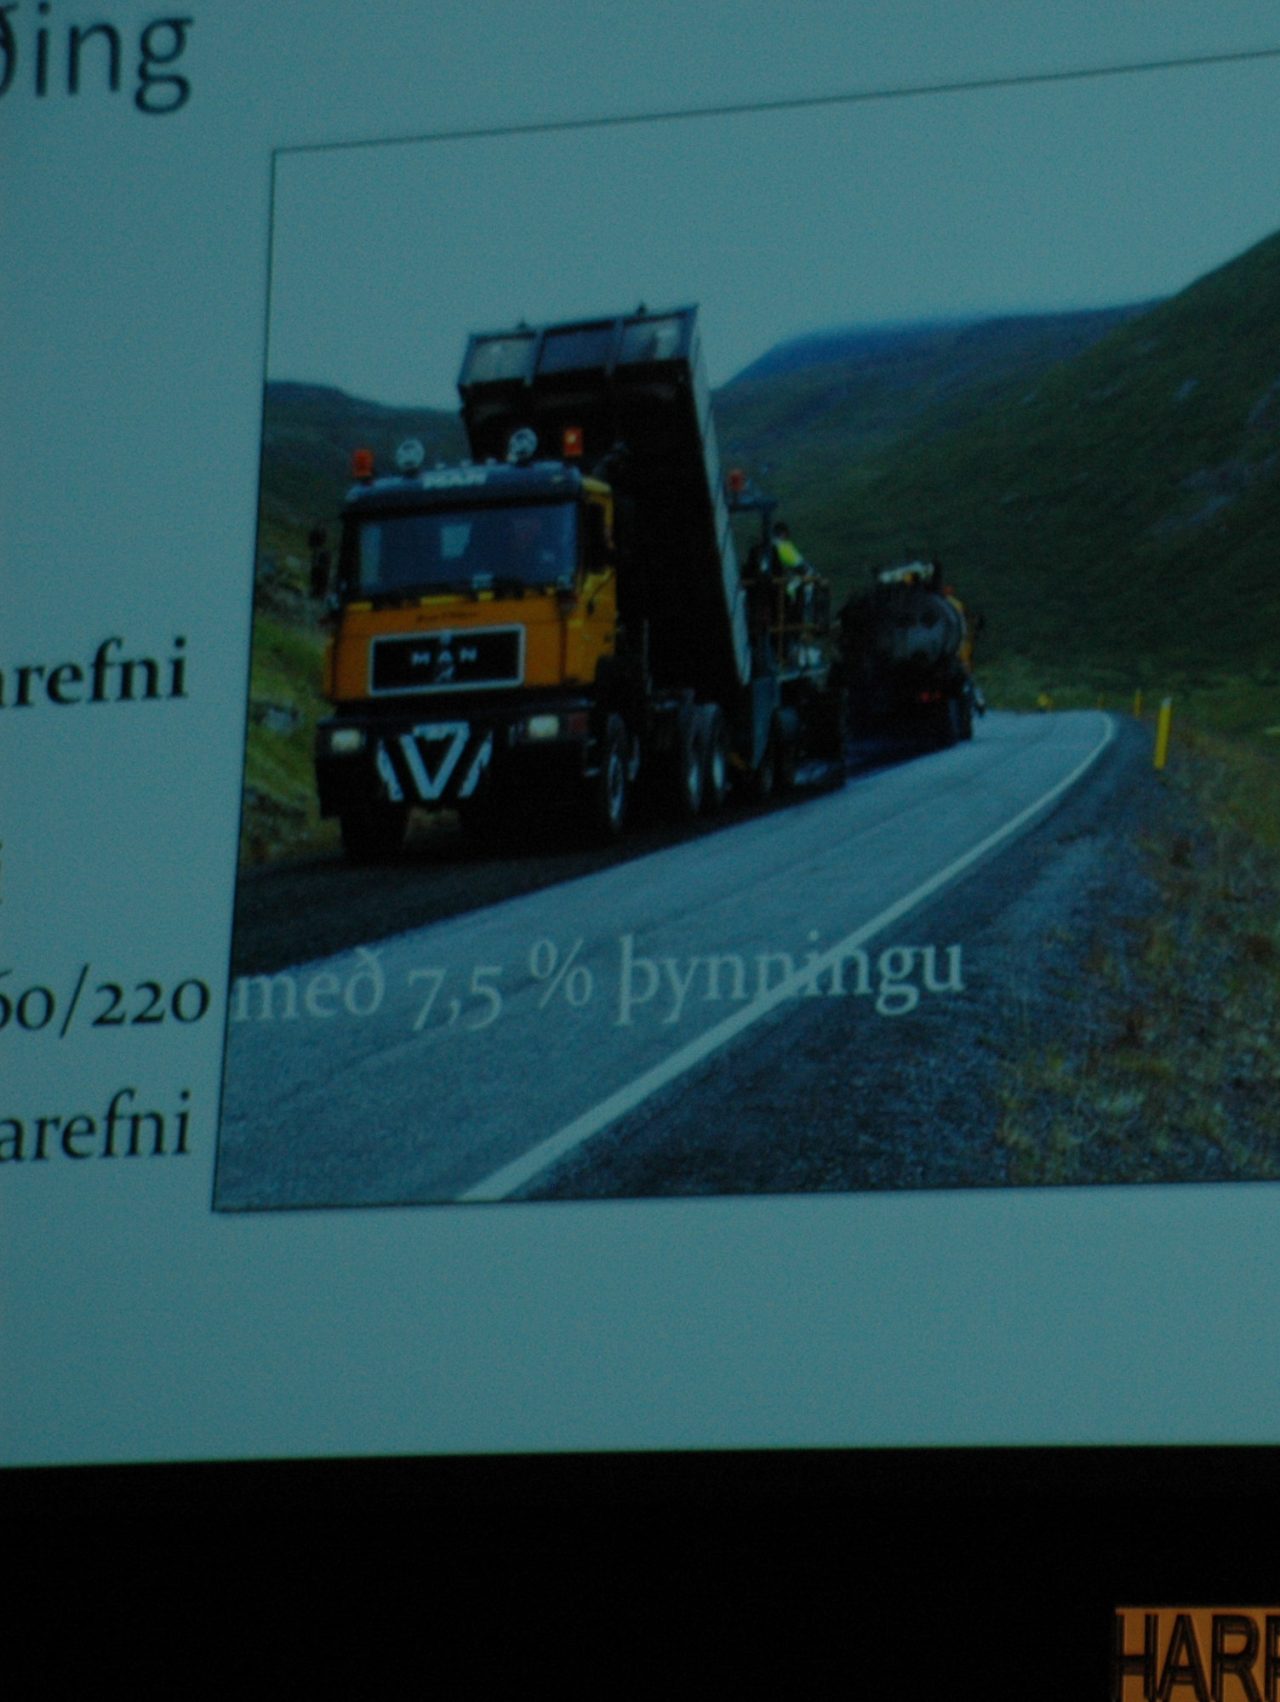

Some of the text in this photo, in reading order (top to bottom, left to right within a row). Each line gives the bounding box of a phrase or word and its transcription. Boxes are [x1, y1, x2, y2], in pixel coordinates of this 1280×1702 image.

[0, 636, 188, 708] refni
[234, 946, 386, 1022] með
[407, 965, 502, 1032] 7,5
[529, 937, 593, 1010] %
[614, 932, 966, 1026] þynningu
